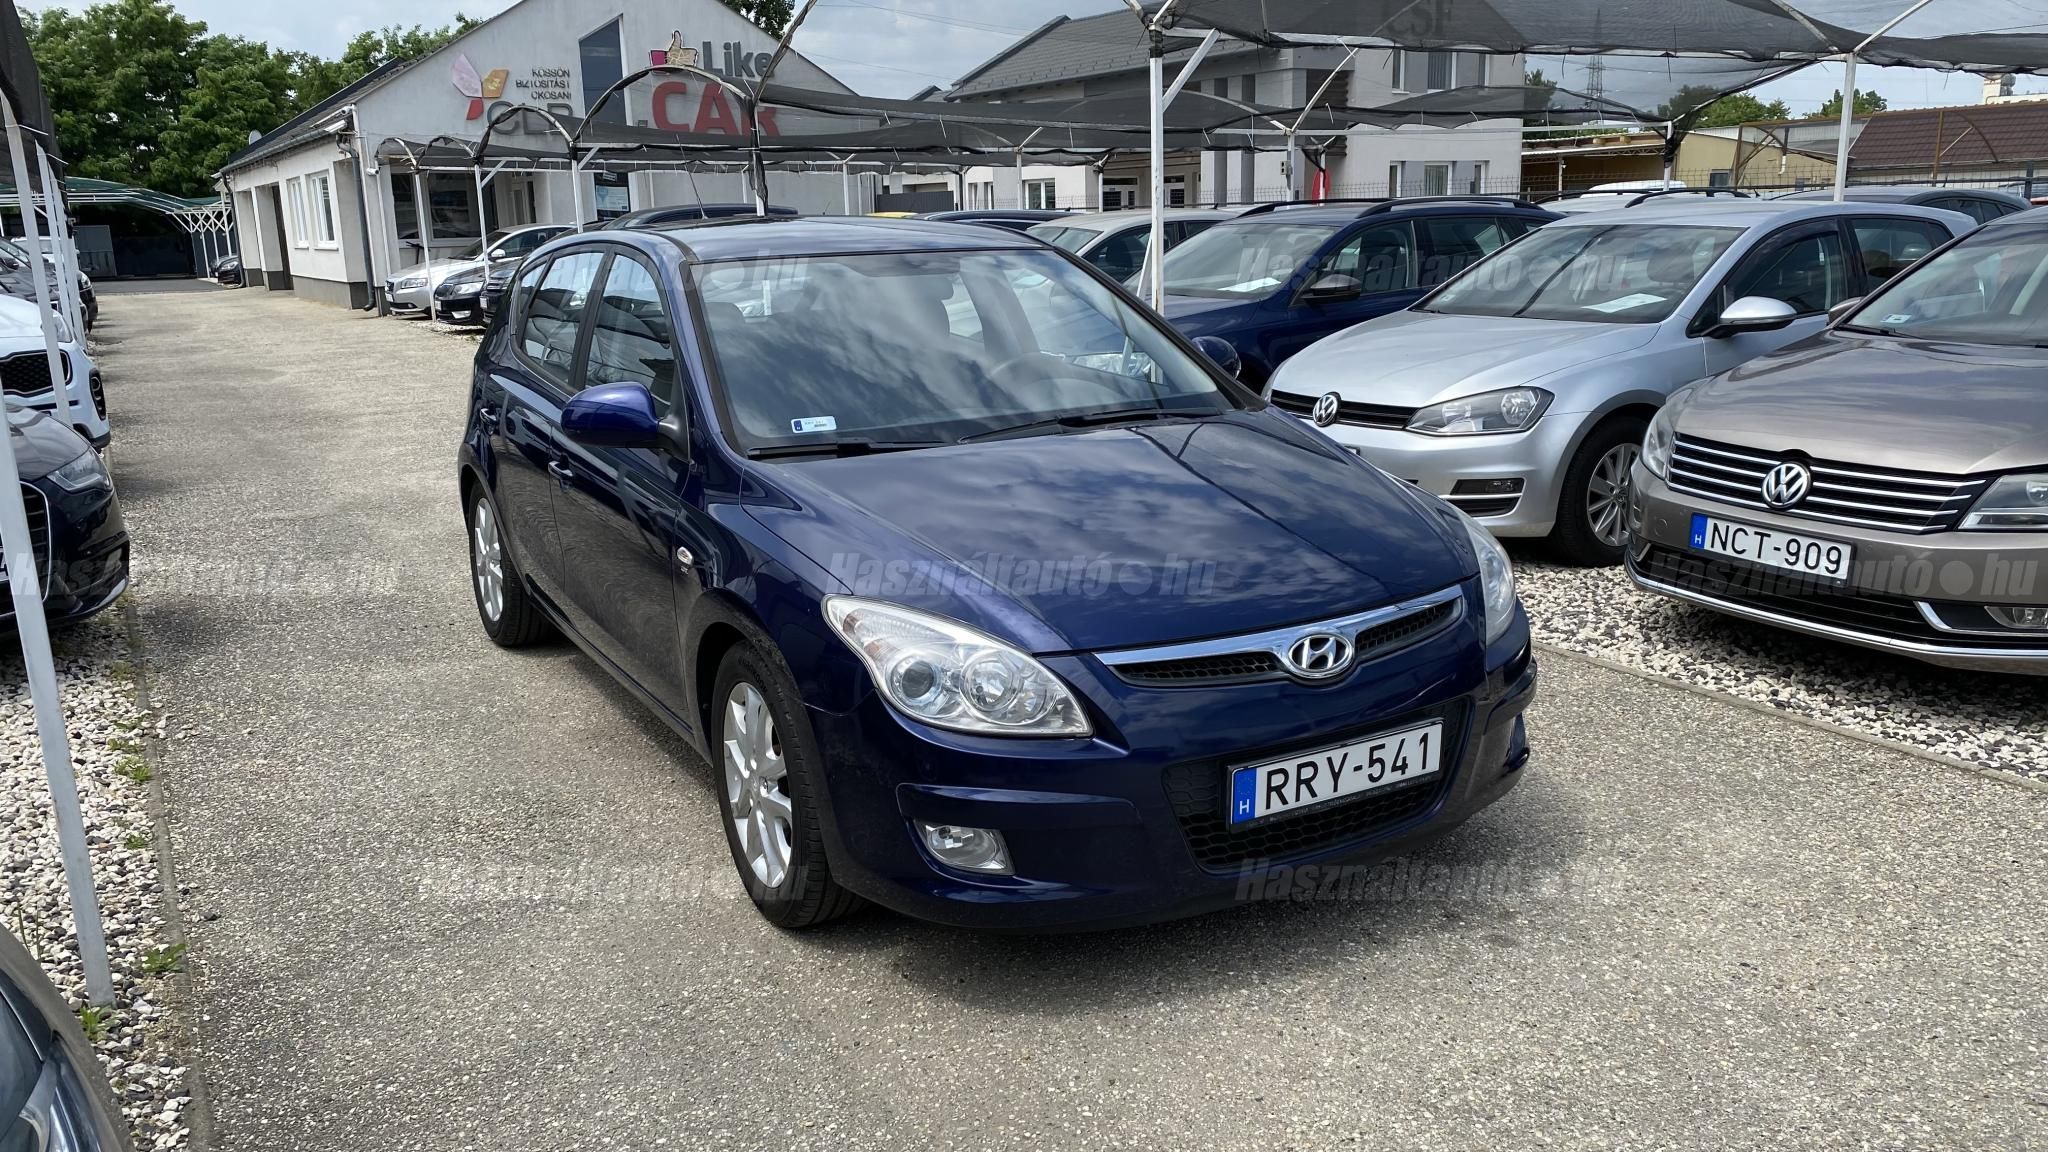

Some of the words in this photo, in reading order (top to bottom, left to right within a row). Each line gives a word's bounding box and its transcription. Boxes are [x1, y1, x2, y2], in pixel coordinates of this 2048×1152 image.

[702, 41, 774, 77] Like
[1711, 523, 1842, 574] NCT-909
[1265, 732, 1430, 810] RRY-541
